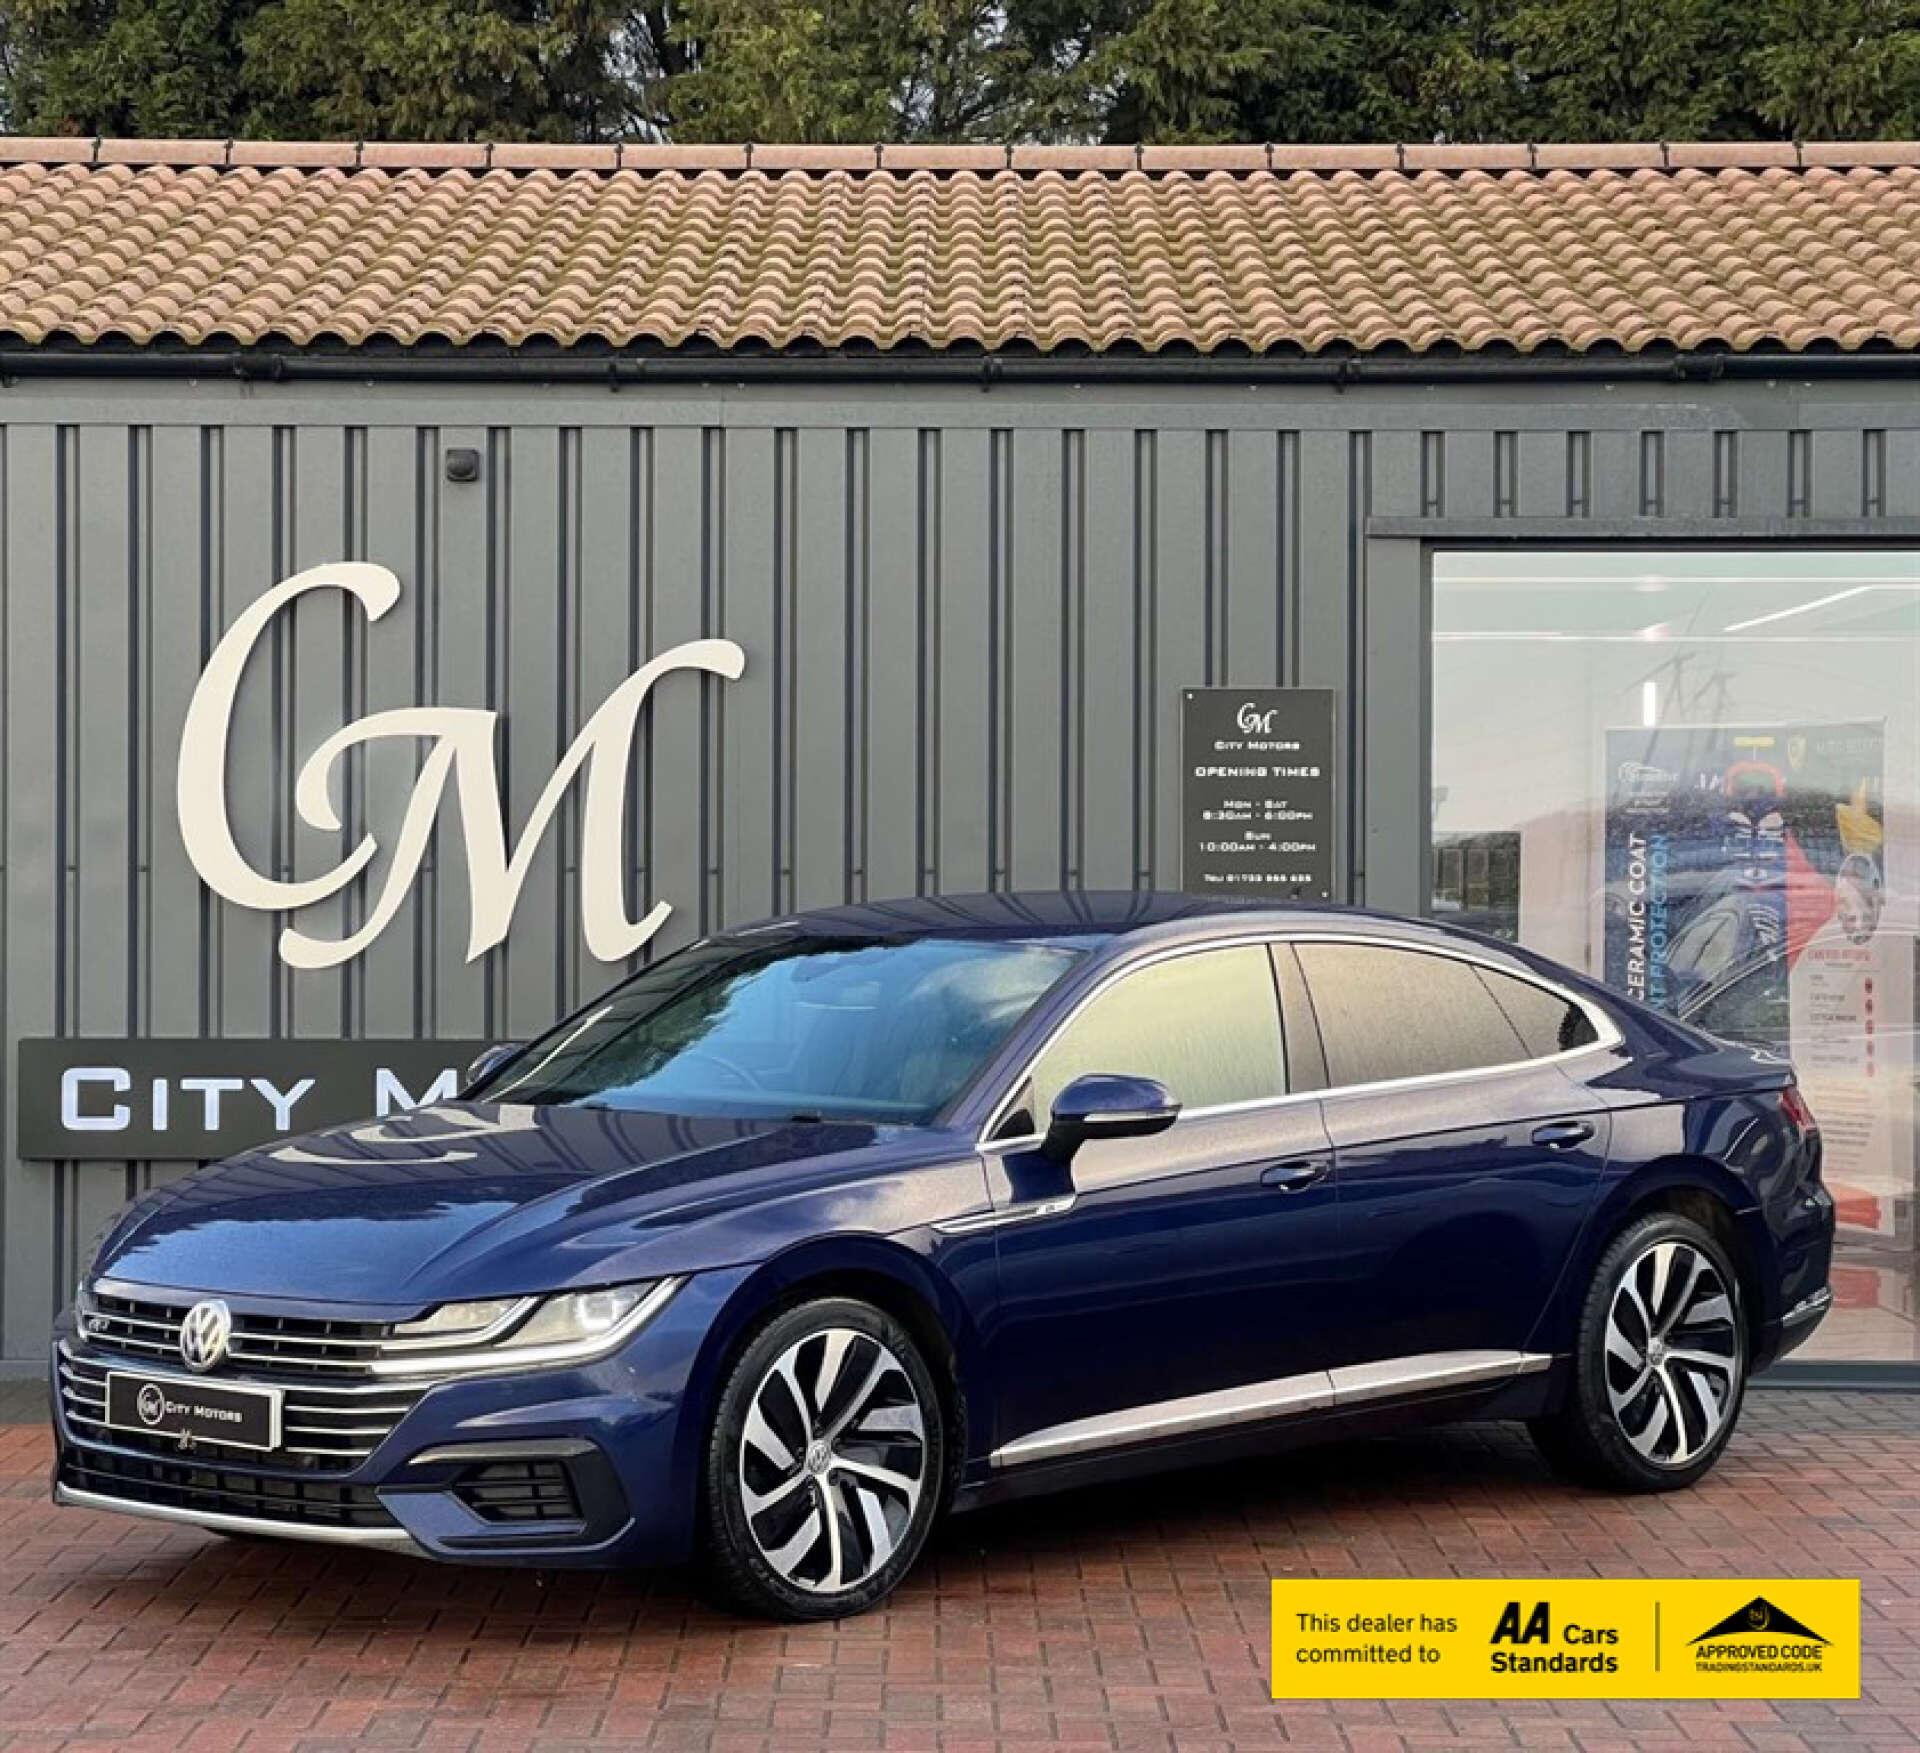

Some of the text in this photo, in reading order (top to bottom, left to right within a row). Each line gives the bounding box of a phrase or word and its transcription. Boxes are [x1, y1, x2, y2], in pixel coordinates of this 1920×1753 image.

[1247, 741, 1300, 750] MOTORS
[1195, 766, 1320, 777] OPENING TIMES
[1628, 832, 1647, 895] COAT
[61, 1067, 316, 1131] CITY
